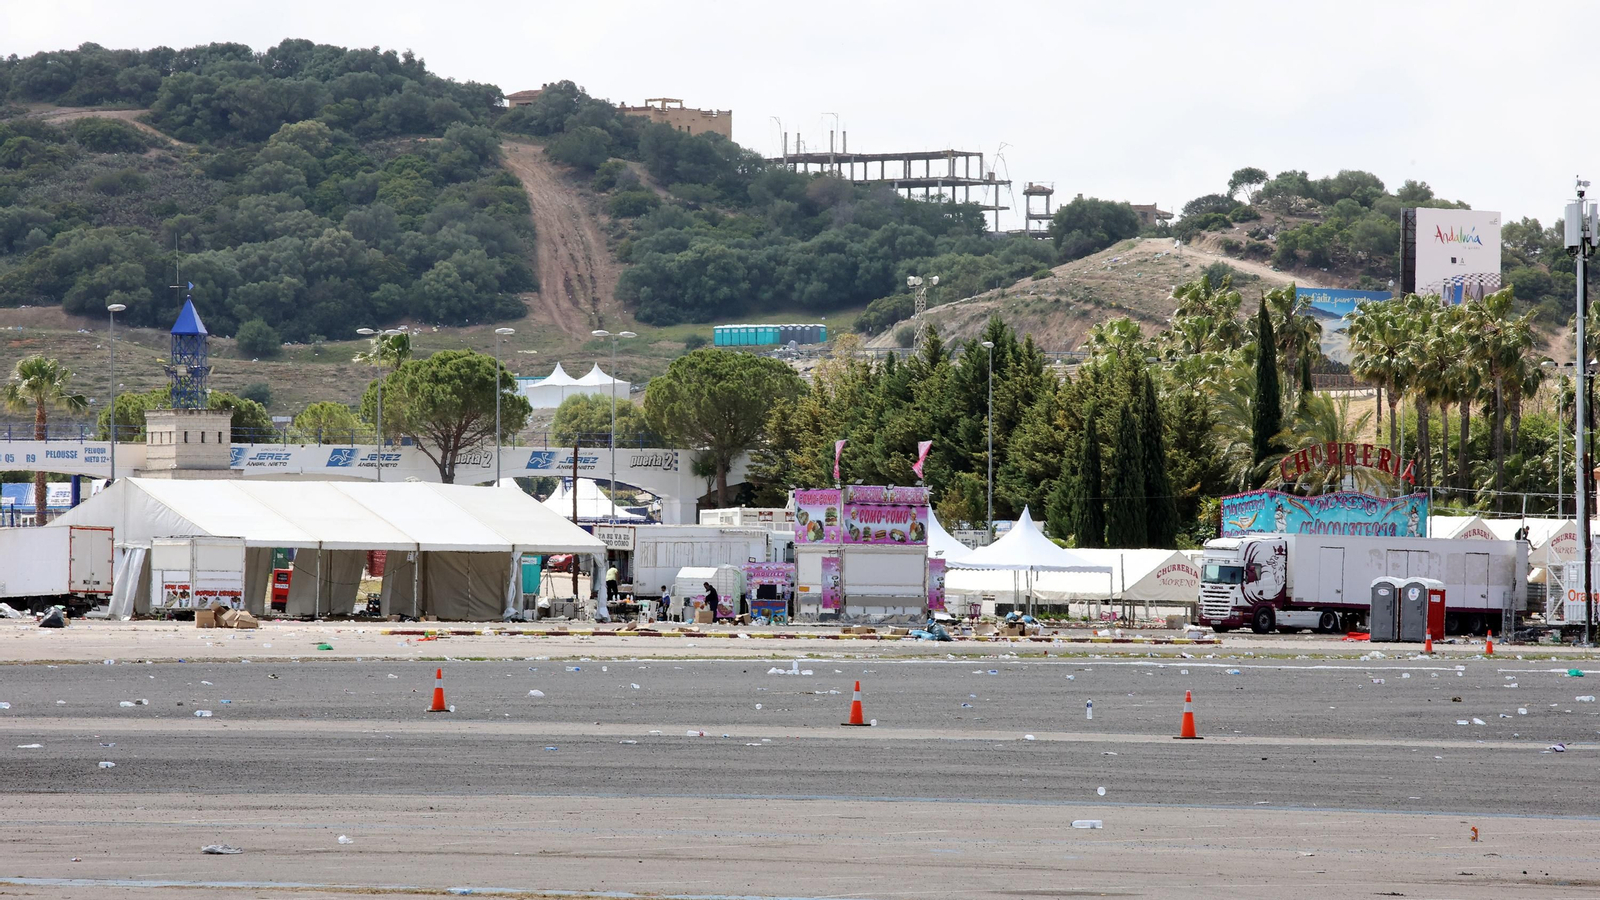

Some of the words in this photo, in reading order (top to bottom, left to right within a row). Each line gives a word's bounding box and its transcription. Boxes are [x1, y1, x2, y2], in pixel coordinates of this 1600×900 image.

[1434, 224, 1483, 246] Andalucía
[45, 450, 78, 459] PELOUSSE
[249, 453, 291, 461] JEREZ
[360, 453, 402, 461] JEREZ
[630, 454, 663, 468] puerta
[663, 452, 674, 470] 2
[1281, 441, 1416, 485] CHURRERIA
[859, 508, 910, 525] COMO-COMO
[1156, 563, 1199, 579] CHURRERIA
[1159, 578, 1196, 588] MORENO
